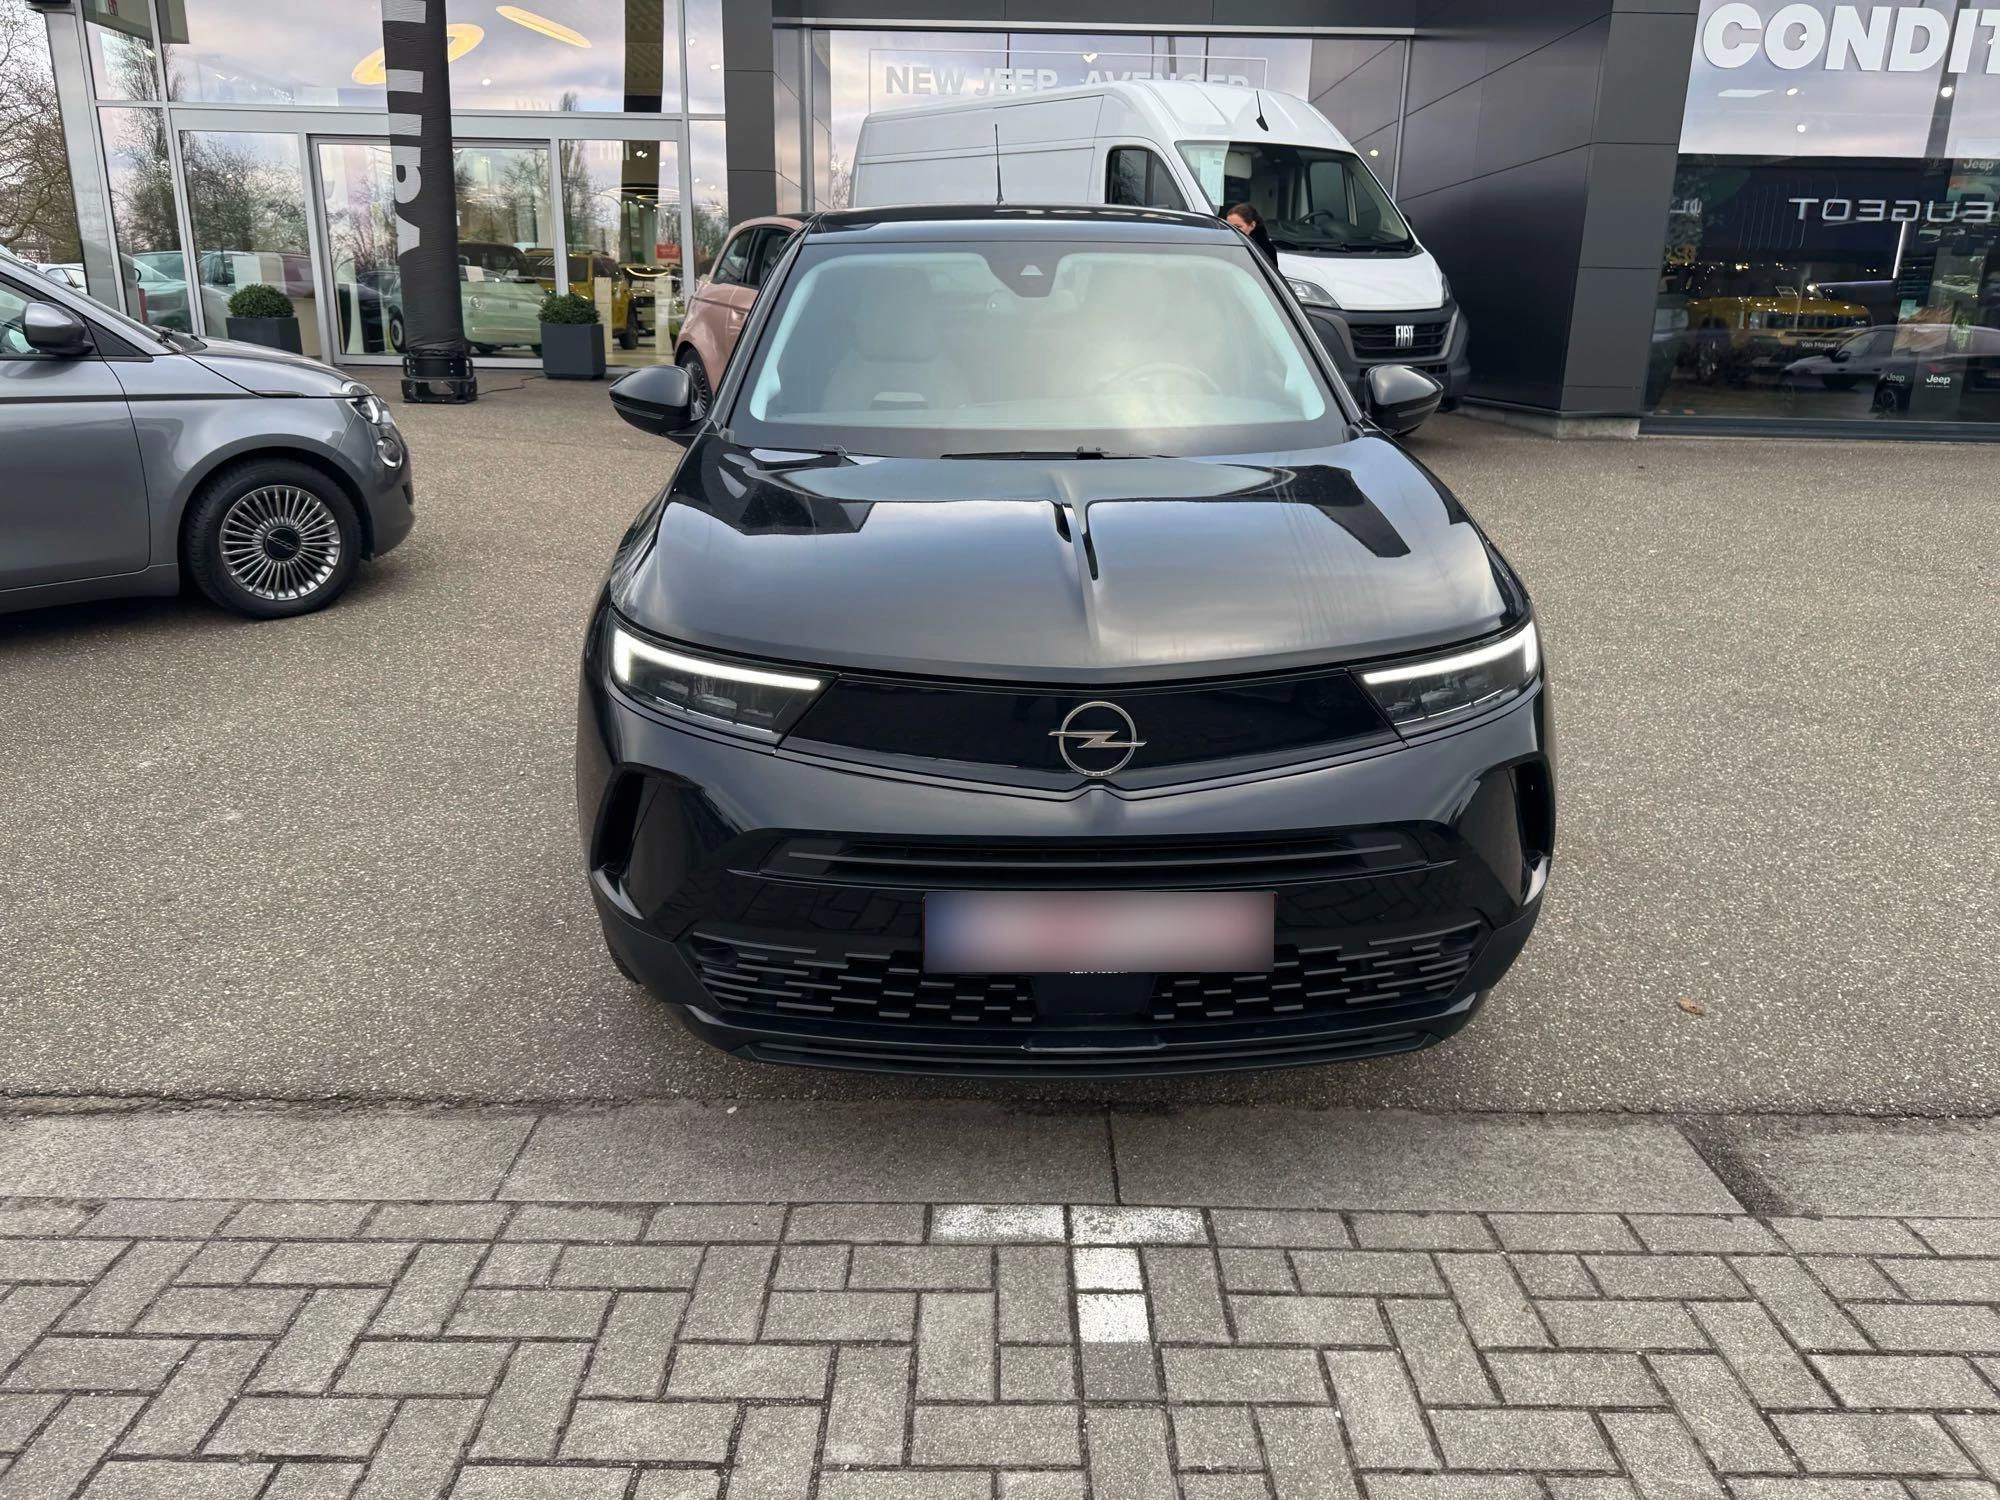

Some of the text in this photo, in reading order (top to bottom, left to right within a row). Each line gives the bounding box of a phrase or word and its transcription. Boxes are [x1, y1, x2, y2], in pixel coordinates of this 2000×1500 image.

[886, 66, 965, 95] NEW
[975, 67, 1058, 96] JEEP
[1395, 325, 1415, 347] FIAT
[1926, 374, 1951, 385] Jeep
